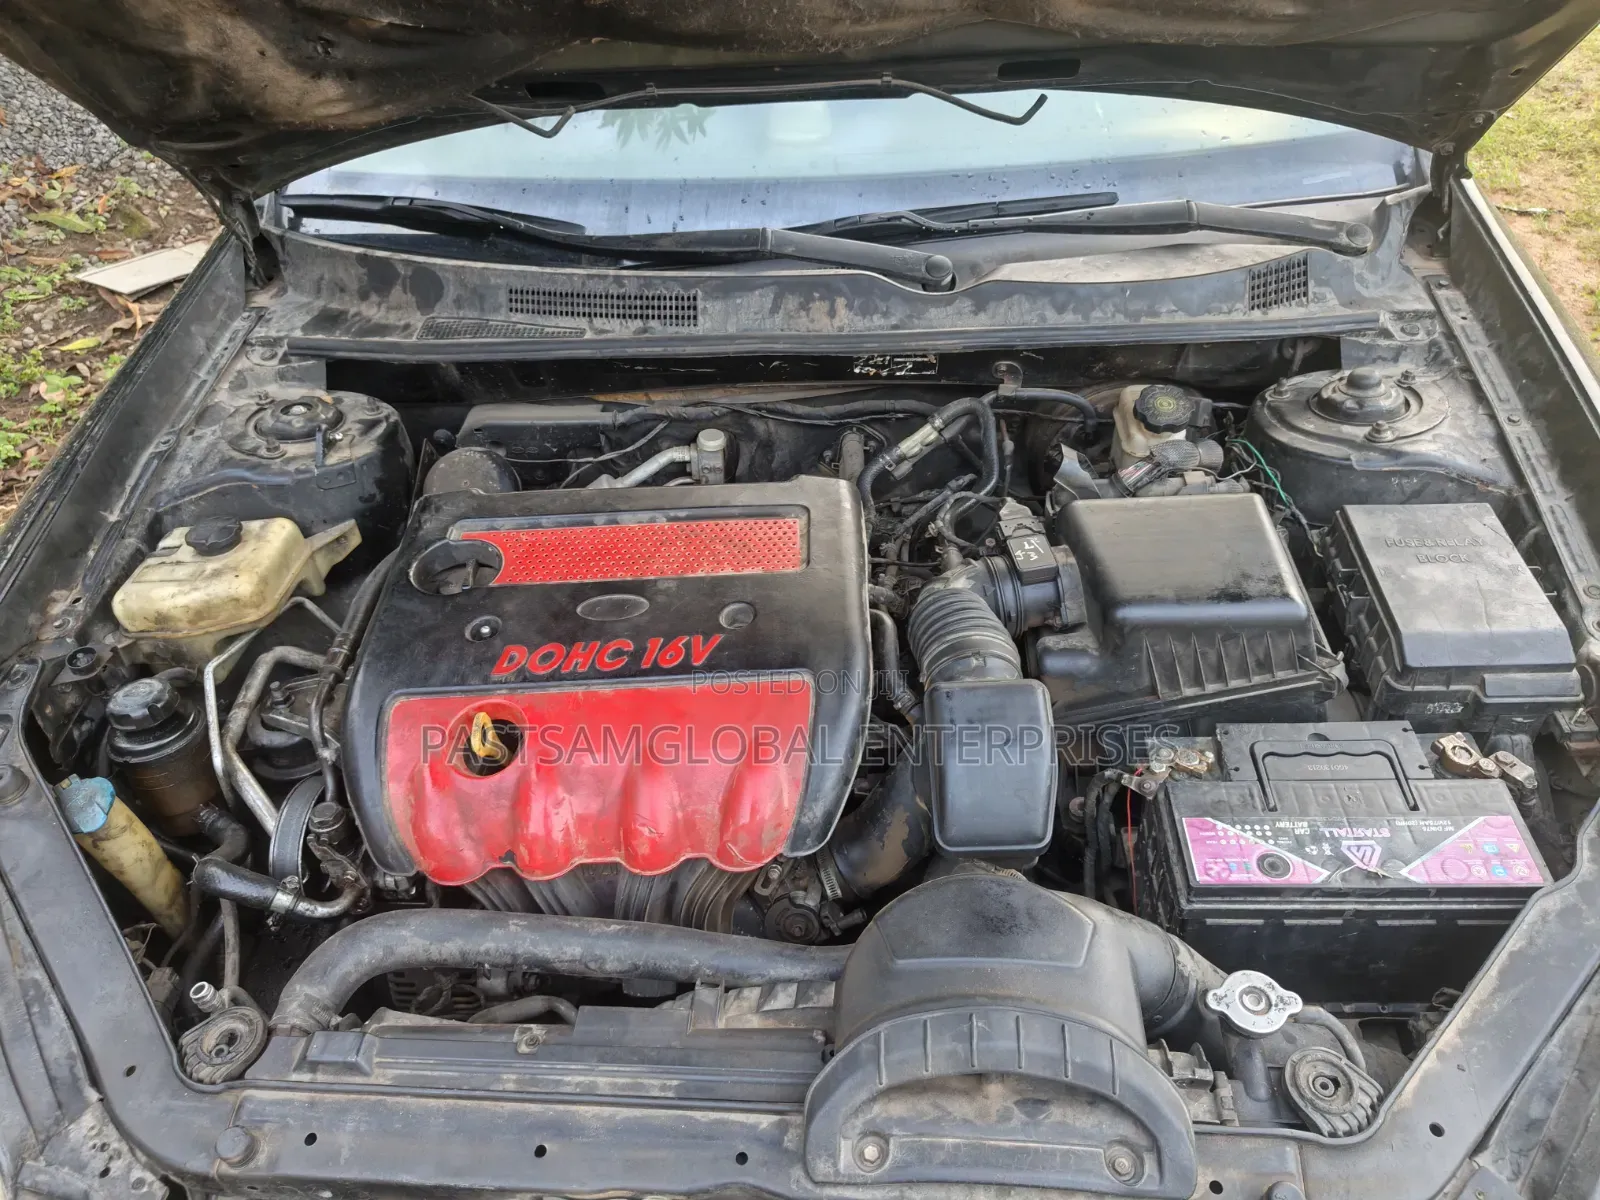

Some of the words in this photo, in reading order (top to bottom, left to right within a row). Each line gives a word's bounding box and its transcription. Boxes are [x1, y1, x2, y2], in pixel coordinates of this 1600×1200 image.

[1416, 553, 1471, 563] BLOCK
[489, 638, 634, 677] DOHC
[640, 632, 724, 670] 16V
[1275, 821, 1309, 829] BATTERY
[1319, 827, 1391, 838] STARTALL
